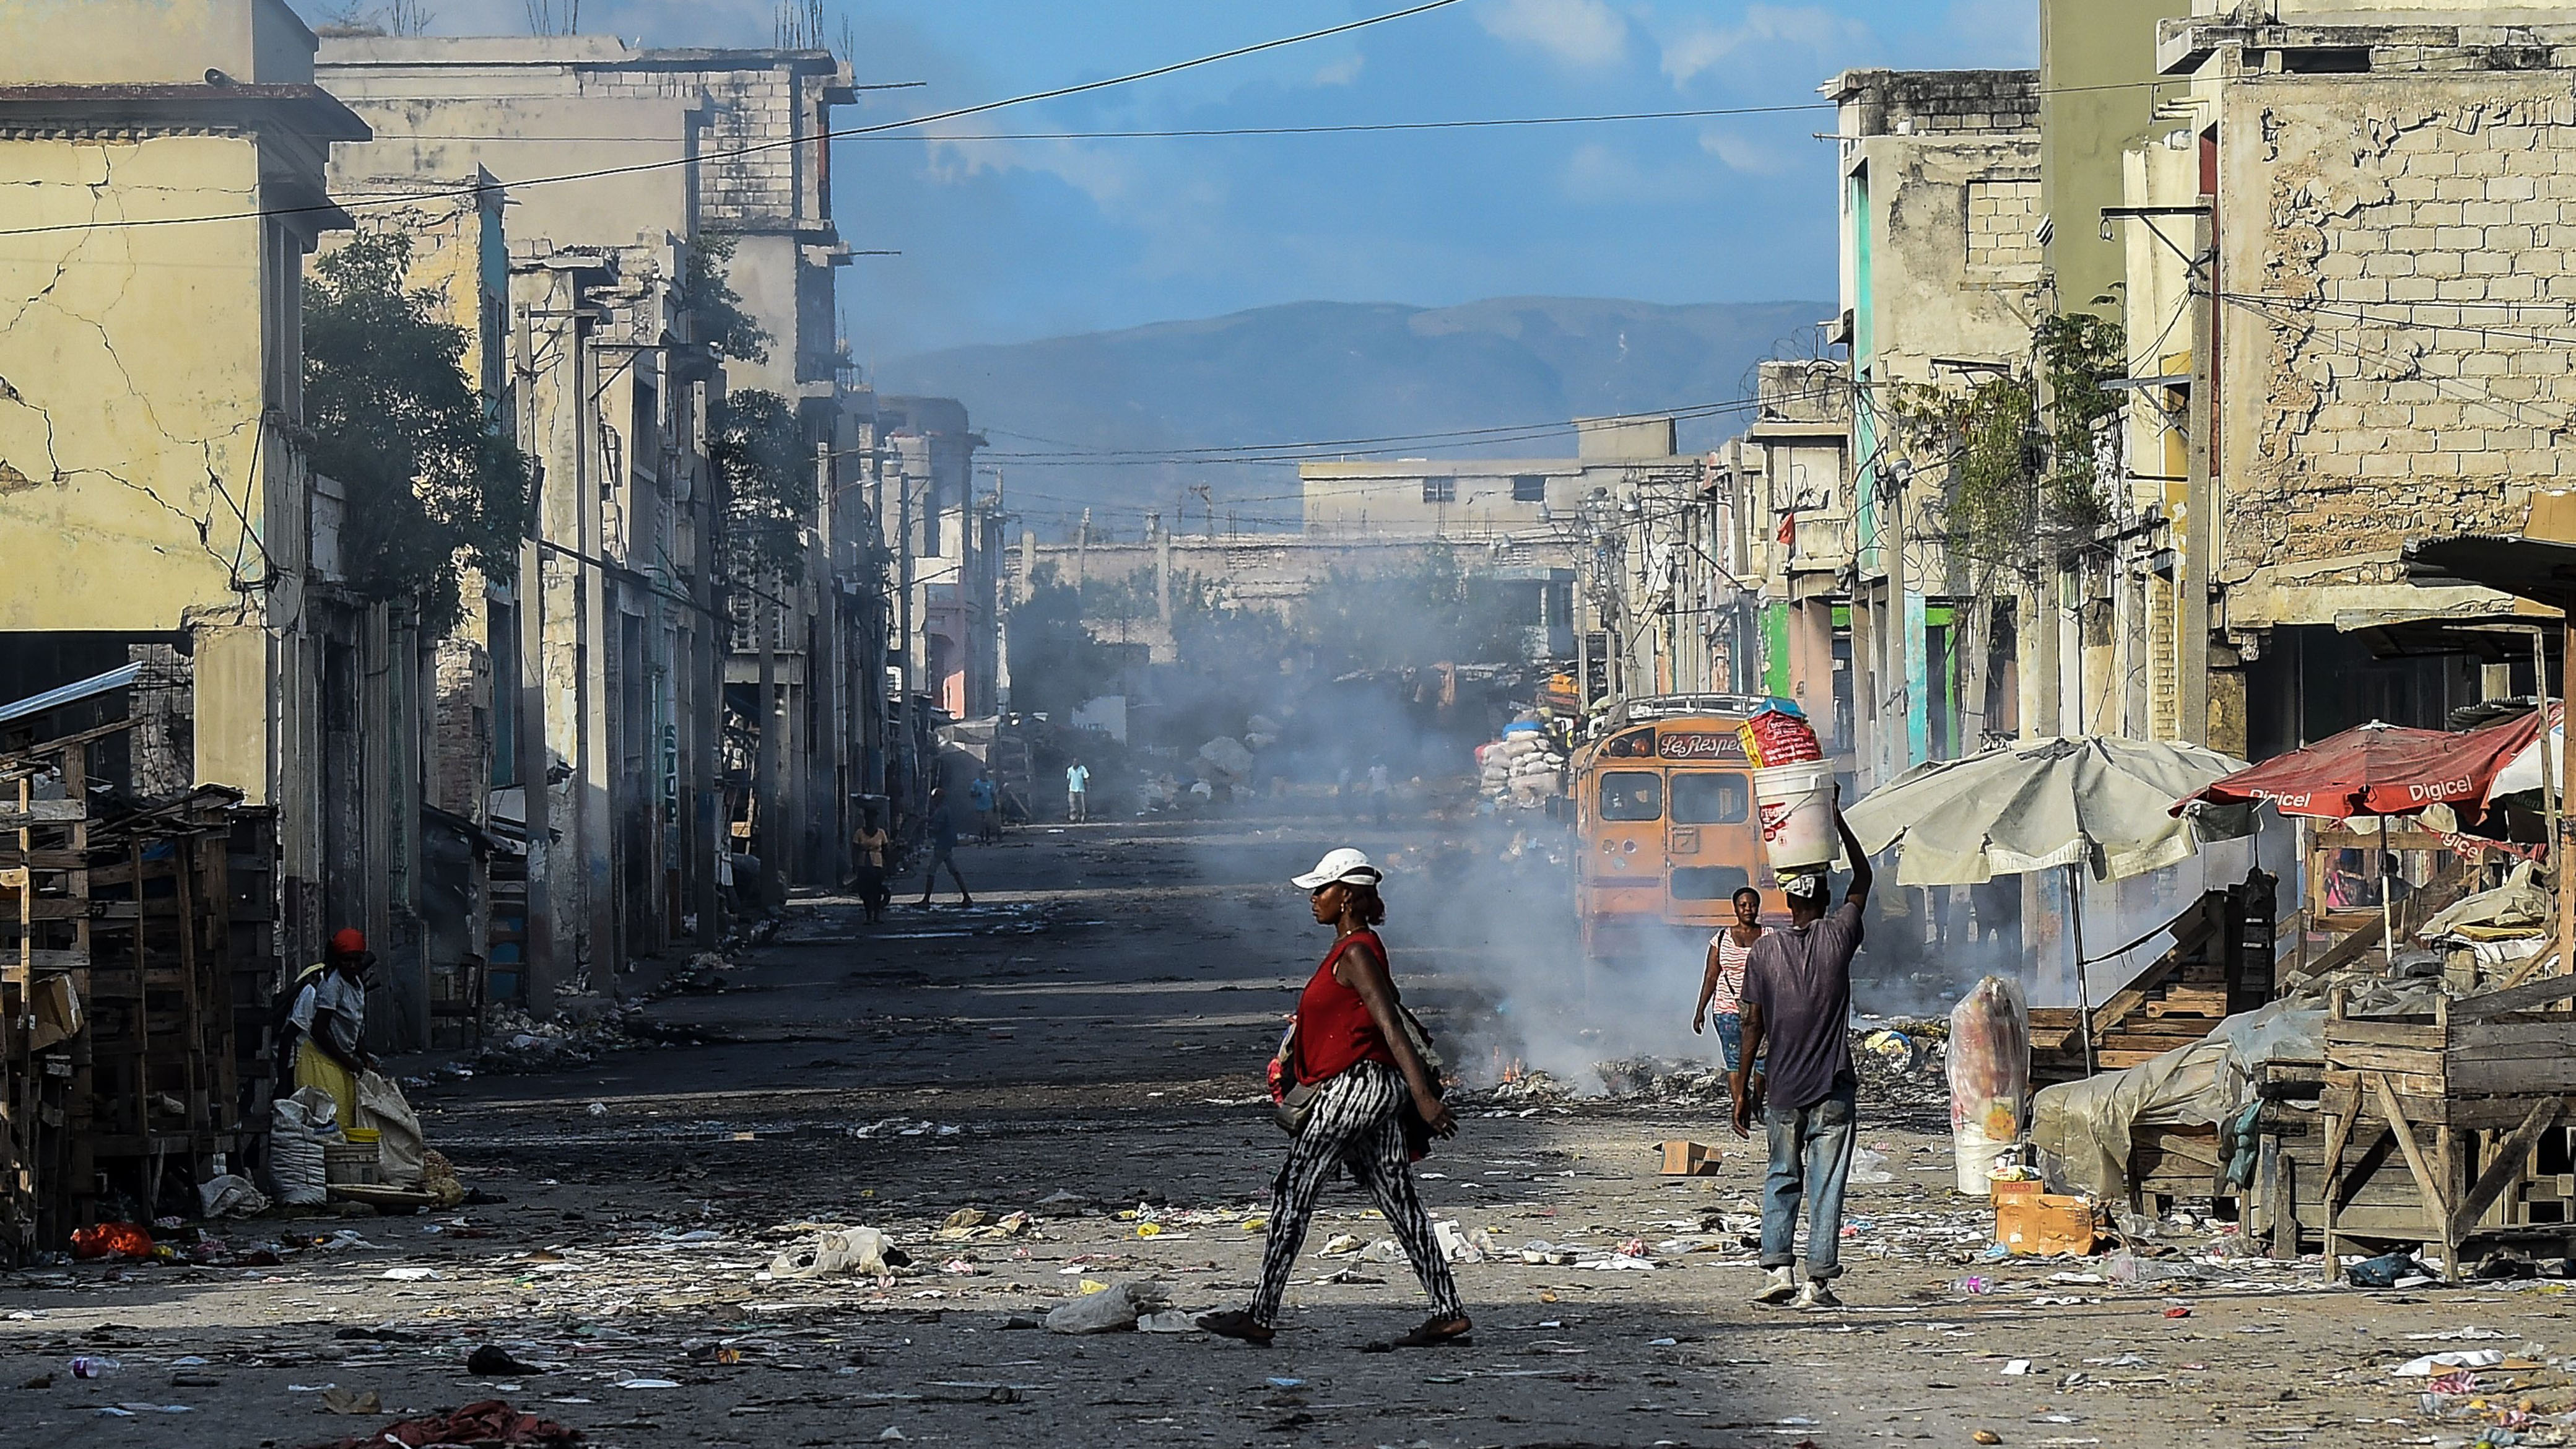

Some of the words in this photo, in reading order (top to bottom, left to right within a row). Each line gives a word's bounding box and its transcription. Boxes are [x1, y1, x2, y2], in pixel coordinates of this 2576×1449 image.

[1661, 735, 1682, 755] Le
[1677, 735, 1744, 757] Respec
[2409, 774, 2473, 801] Digicel
